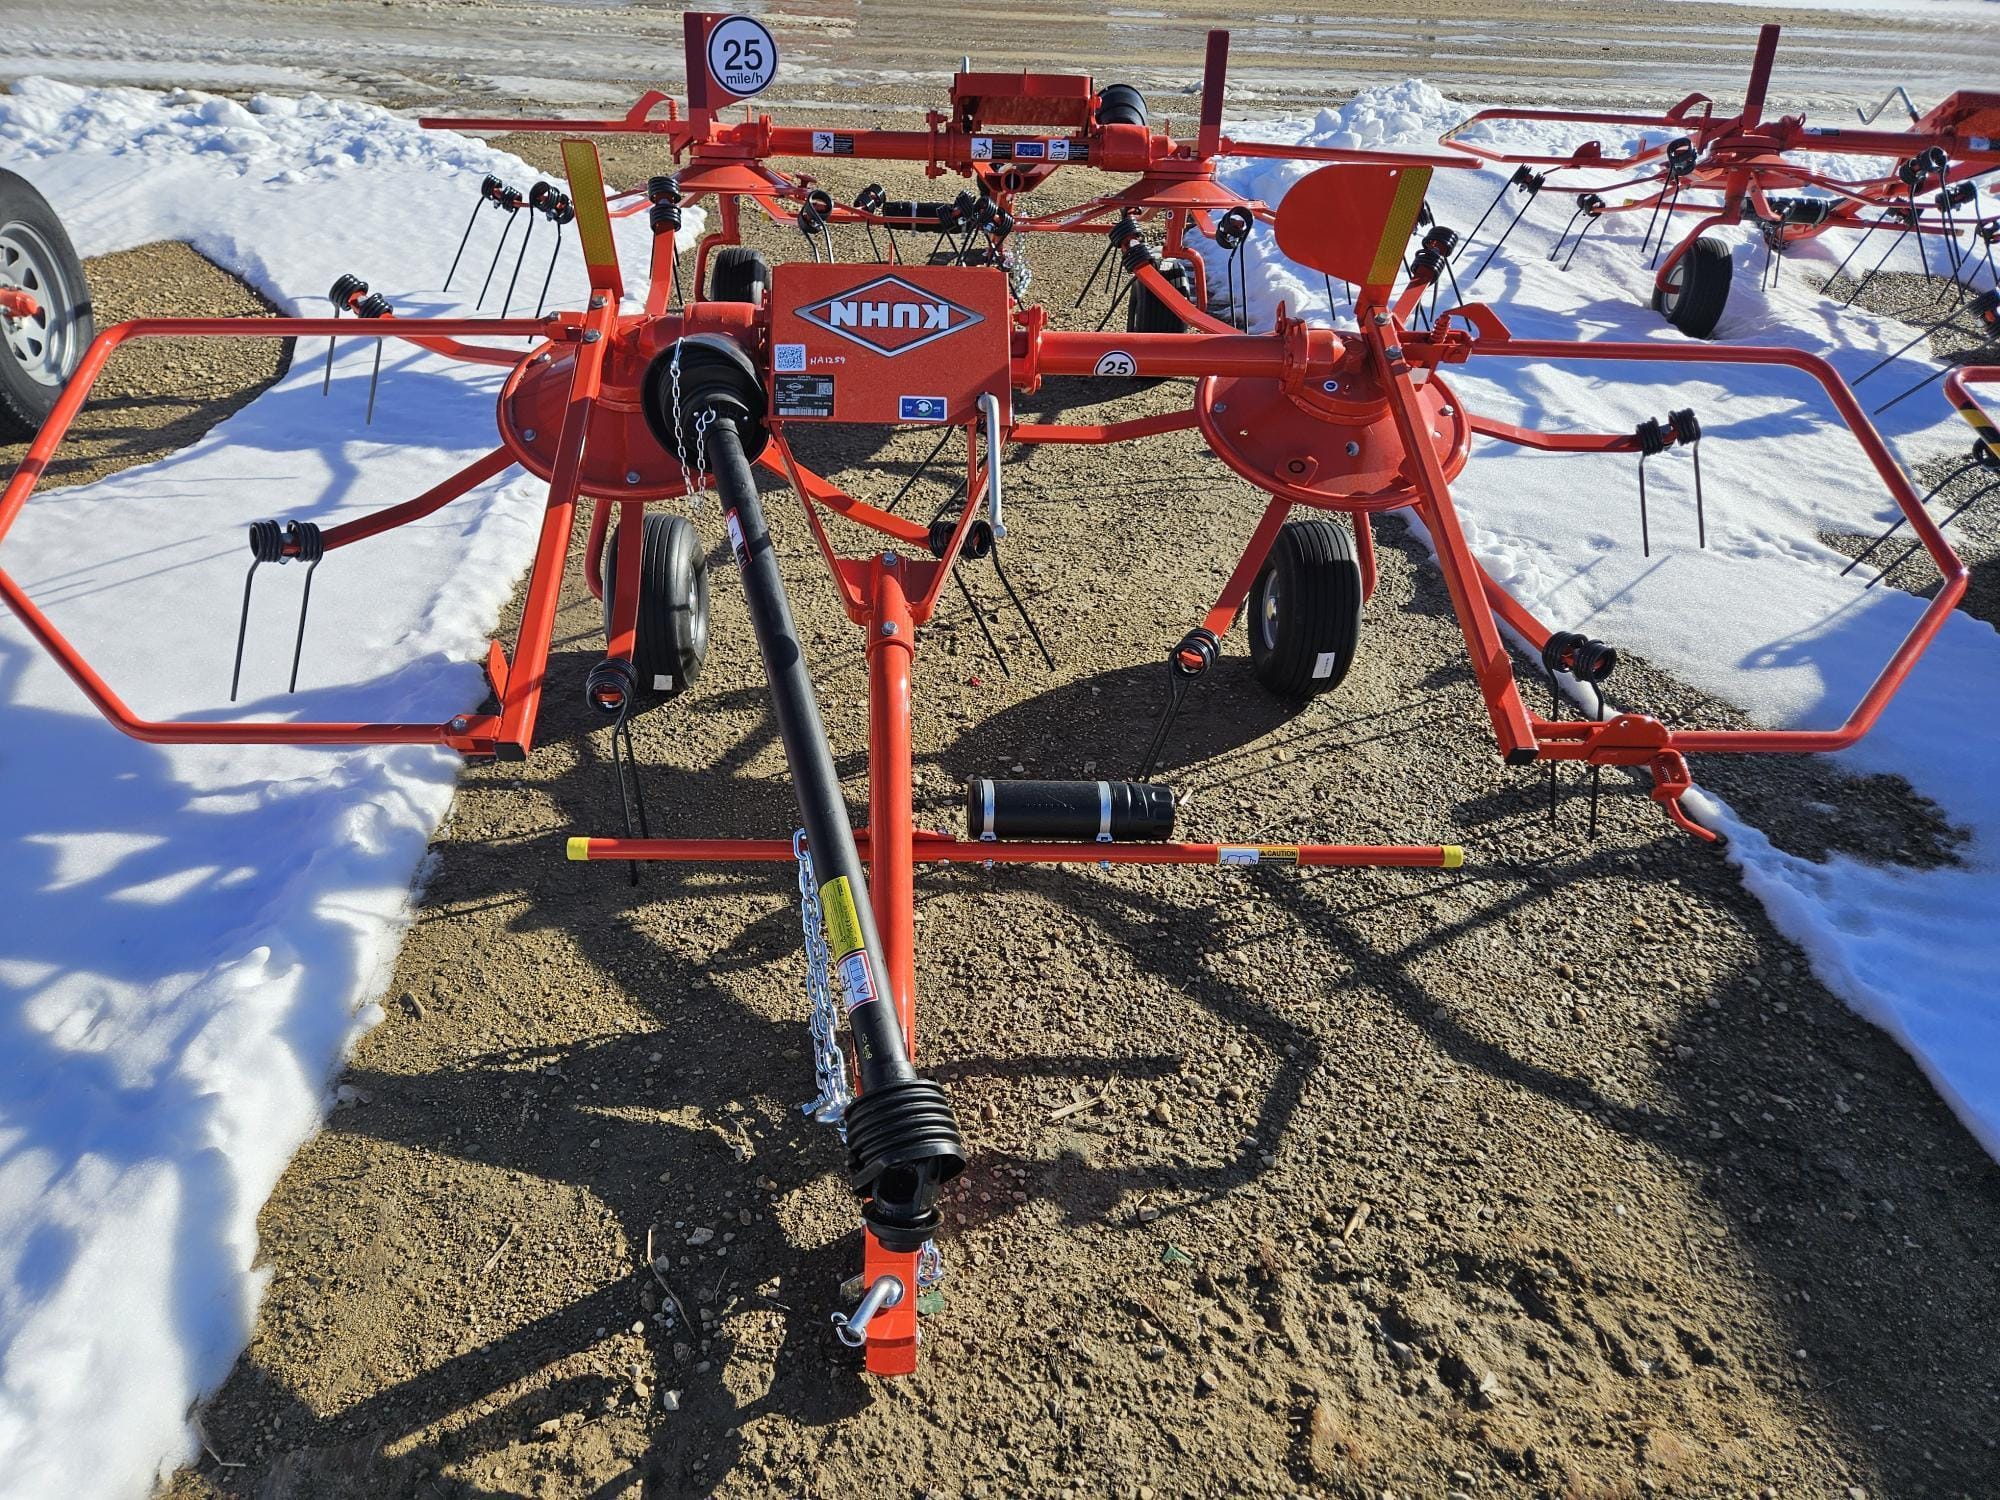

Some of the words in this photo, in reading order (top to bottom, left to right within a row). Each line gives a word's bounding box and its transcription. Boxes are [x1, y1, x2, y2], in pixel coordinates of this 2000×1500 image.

[723, 39, 763, 70] 25
[726, 72, 763, 84] mile/h
[830, 300, 949, 330] KUHN
[810, 356, 845, 365] HA1259
[1104, 361, 1128, 374] 25
